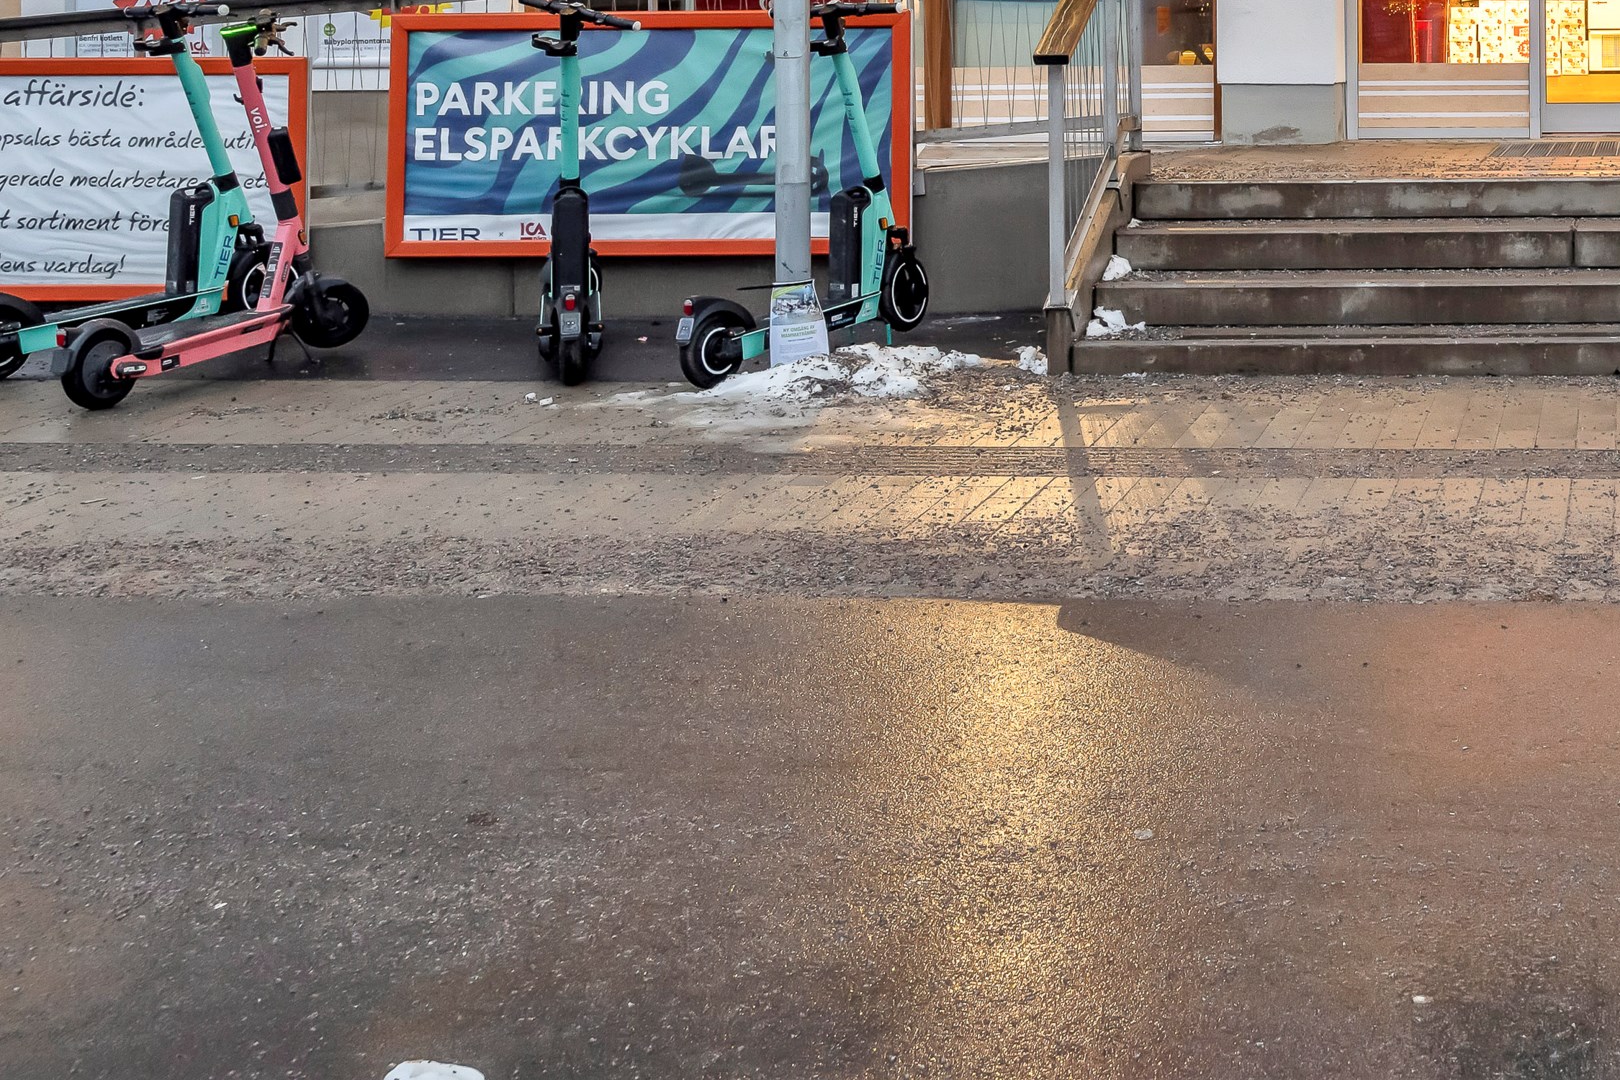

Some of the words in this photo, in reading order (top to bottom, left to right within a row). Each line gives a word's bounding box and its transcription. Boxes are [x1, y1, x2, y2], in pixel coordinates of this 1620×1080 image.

[190, 41, 209, 50] ICA
[3, 79, 145, 108] affärsidé:
[416, 80, 670, 116] PARKEING
[250, 107, 267, 133] voi.
[0, 127, 62, 151] psalas
[68, 128, 121, 147] bästa
[69, 169, 199, 190] medarbetare
[16, 209, 121, 231] sortiment
[188, 204, 196, 225] TIER
[409, 227, 481, 241] TIER
[520, 222, 547, 236] ICA
[0, 252, 37, 273] ens
[43, 253, 125, 280] vardag!
[214, 235, 234, 280] TIER
[872, 239, 885, 285] TIER
